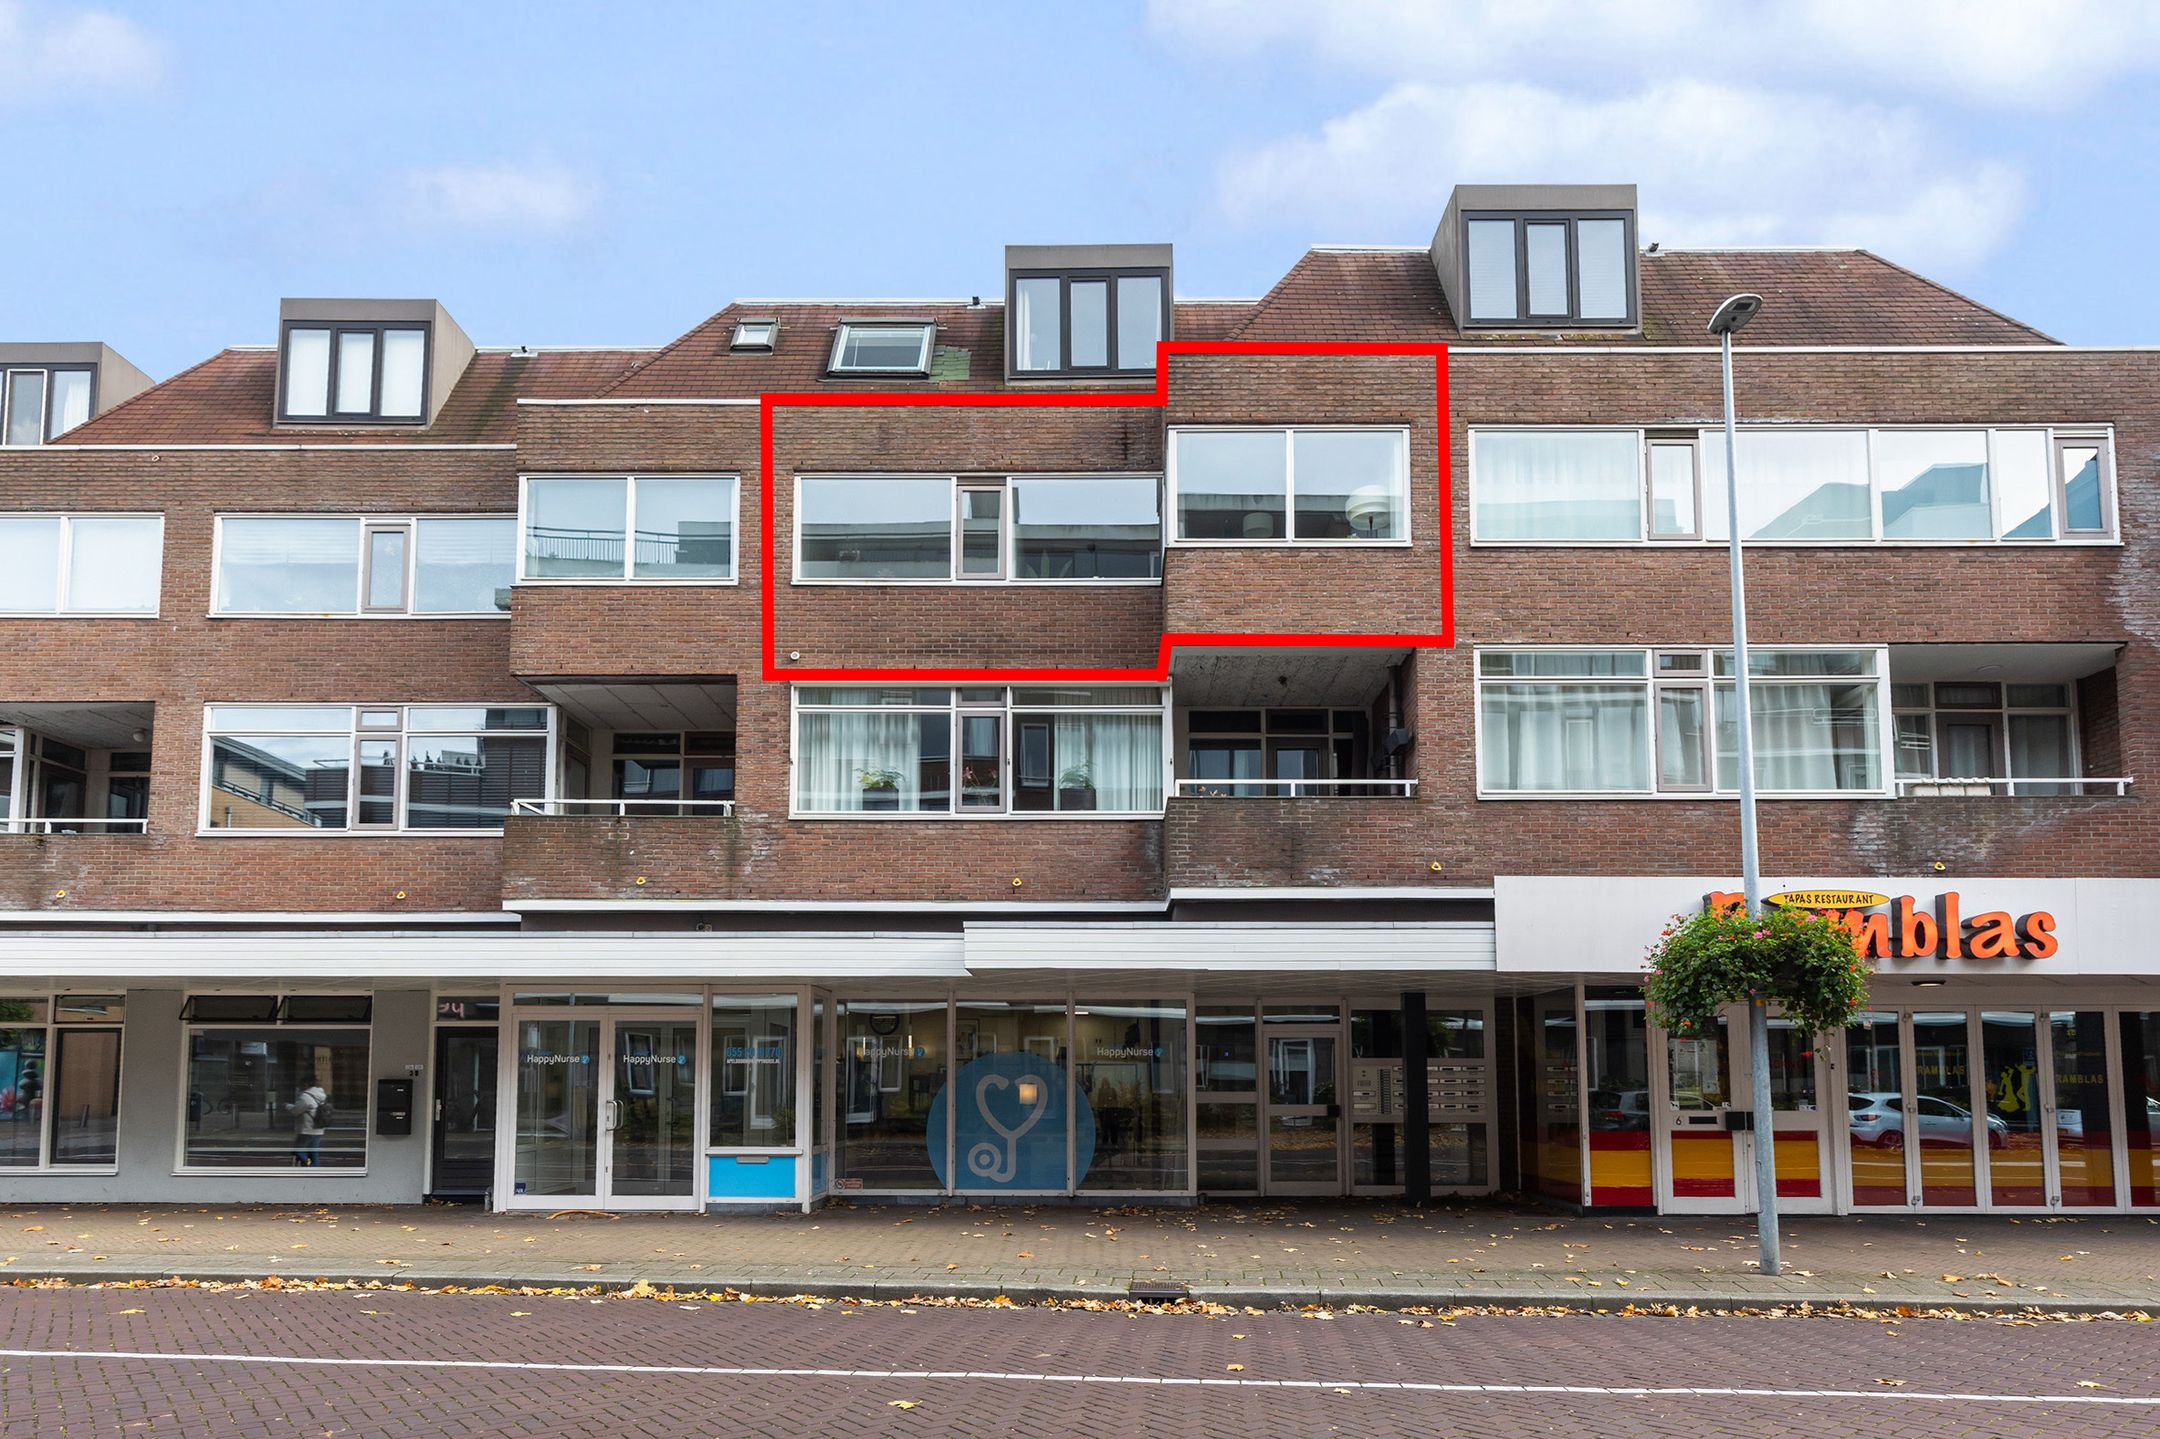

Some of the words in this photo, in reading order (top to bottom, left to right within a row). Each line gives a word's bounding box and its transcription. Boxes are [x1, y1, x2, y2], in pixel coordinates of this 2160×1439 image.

[1783, 894, 1812, 904] TAPAS
[1814, 894, 1874, 904] RESTAURANT
[1704, 891, 2058, 959] mblas
[1096, 1047, 1154, 1059] HappyNurse
[527, 1054, 580, 1065] HappyNurse
[623, 1054, 676, 1065] HappyNurse
[1916, 1065, 1965, 1075] RAMLAS
[2055, 1074, 2104, 1084] RAMBLAS
[1675, 1116, 1682, 1125] 6
